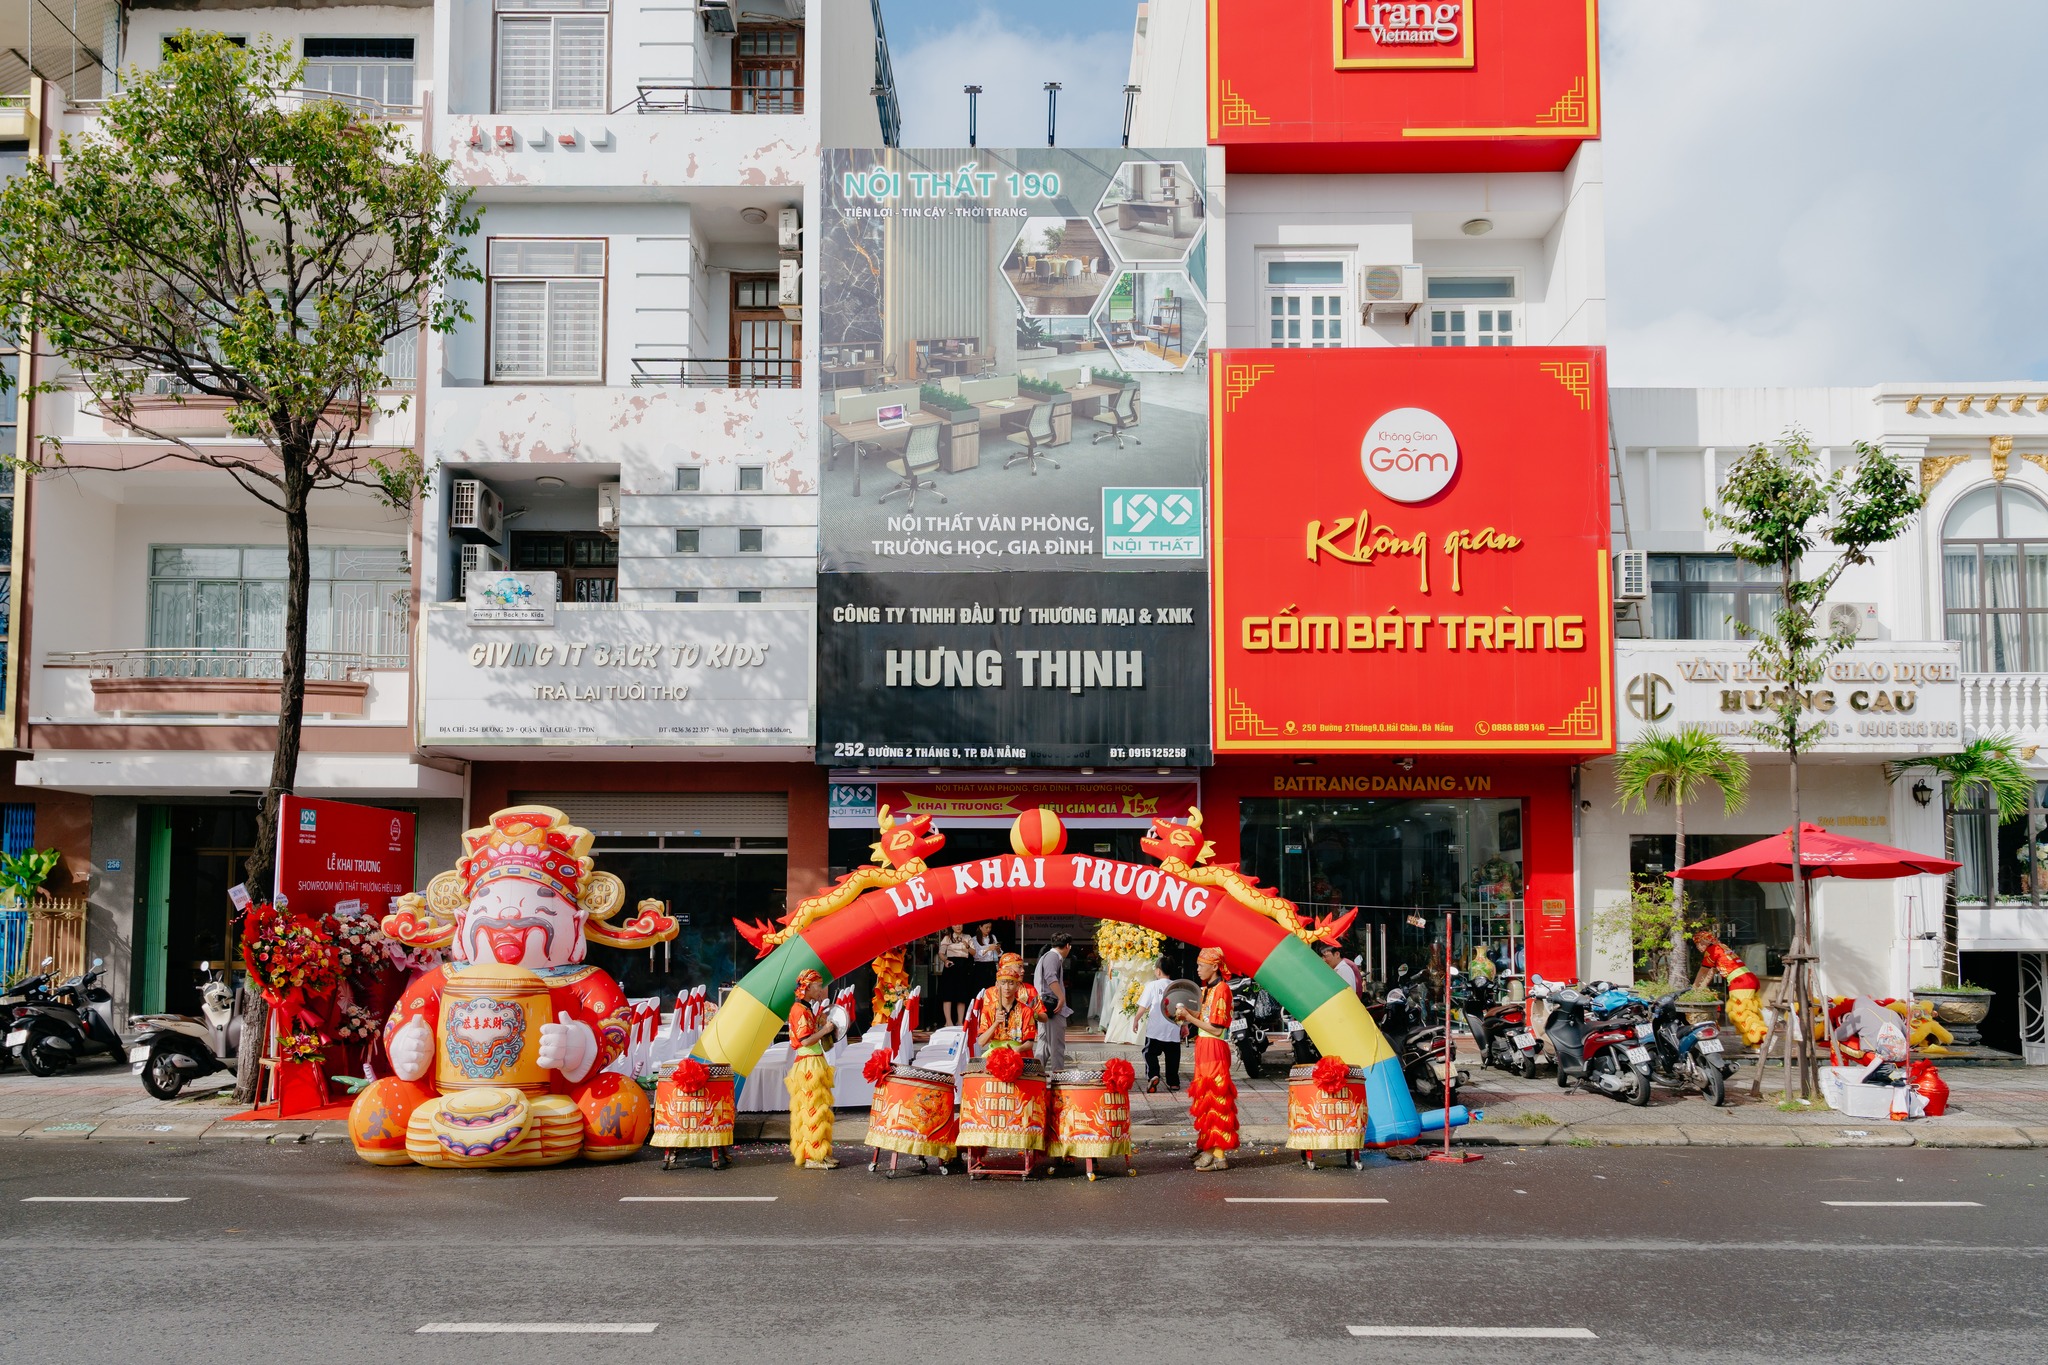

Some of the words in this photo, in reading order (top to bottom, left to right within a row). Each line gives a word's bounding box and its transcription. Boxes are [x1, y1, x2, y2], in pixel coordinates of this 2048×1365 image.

[1370, 27, 1438, 44] Vietnam
[845, 168, 899, 201] NỘI
[910, 163, 996, 198] THẤT
[1007, 173, 1060, 198] 190
[844, 205, 871, 219] TIỆN
[874, 206, 893, 219] LỢI
[902, 207, 921, 218] TIN
[924, 204, 948, 219] CẬY
[955, 203, 985, 218] THỜI
[987, 207, 1028, 218] TRANG
[1378, 431, 1411, 443] Không
[1413, 431, 1438, 441] Gian
[1369, 447, 1448, 472] Gốm
[1113, 494, 1193, 533] 190
[888, 514, 922, 535] NỘI
[925, 511, 973, 532] THẤT
[977, 514, 1016, 532] VĂN
[1020, 513, 1095, 534] PHÒNG,
[872, 536, 953, 555] TRƯỜNG
[958, 540, 1003, 559] HỌC,
[1007, 540, 1040, 555] GIA
[1044, 536, 1094, 555] ĐÌNH
[1112, 537, 1143, 553] NỘI
[1150, 536, 1194, 551] THẤT
[1306, 509, 1429, 593] Không
[1444, 526, 1522, 593] gian
[833, 603, 880, 624] CÔNG
[885, 607, 905, 624] TY
[910, 607, 955, 624] TNHH
[960, 602, 994, 624] ĐẦU
[999, 606, 1023, 624] TƯ
[1029, 607, 1097, 624] THƯƠNG
[1101, 608, 1135, 627] MẠI
[1139, 608, 1152, 624] &
[1157, 608, 1194, 624] XNK
[1242, 603, 1343, 651] GỐM
[1346, 605, 1432, 651] BÁT
[1438, 606, 1584, 651] TRÀNG
[468, 642, 553, 667] GIVING
[558, 643, 588, 667] IT
[593, 642, 663, 668] BACK
[671, 643, 701, 667] TO
[705, 643, 769, 667] KIDS
[885, 646, 1002, 687] HƯNG
[1016, 650, 1143, 694] THỊNH
[1676, 657, 1727, 682] VĂN
[1828, 661, 1890, 682] GIAO
[1894, 661, 1957, 686] DỊCH
[532, 680, 568, 701] TRẢ
[574, 686, 601, 703] LẠI
[606, 681, 646, 700] TUỔI
[1850, 690, 1917, 712] CAU
[1302, 723, 1317, 732] 250
[1491, 723, 1512, 732] 0886
[1513, 723, 1530, 732] 889
[1531, 723, 1545, 732] 146
[1859, 721, 1896, 737] 0905
[1899, 721, 1924, 737] 583
[834, 742, 864, 758] 252
[868, 743, 903, 758] ĐƯỜNG
[905, 747, 913, 758] 2
[914, 744, 950, 758] THÁNG
[952, 747, 961, 760] 9,
[980, 743, 993, 758] ĐÀ
[1110, 748, 1125, 759] ĐT:
[1032, 784, 1048, 792] GIA
[1274, 776, 1491, 792] BATTRANGDANANG.VN
[832, 785, 872, 805] 190
[917, 802, 947, 811] KHAI
[1128, 799, 1154, 813] 15%
[107, 860, 121, 869] 256
[337, 858, 353, 871] KHAI
[298, 880, 334, 891] SHOWROOM
[951, 857, 1046, 895] KHAI
[1071, 856, 1210, 918] TRƯƠNG
